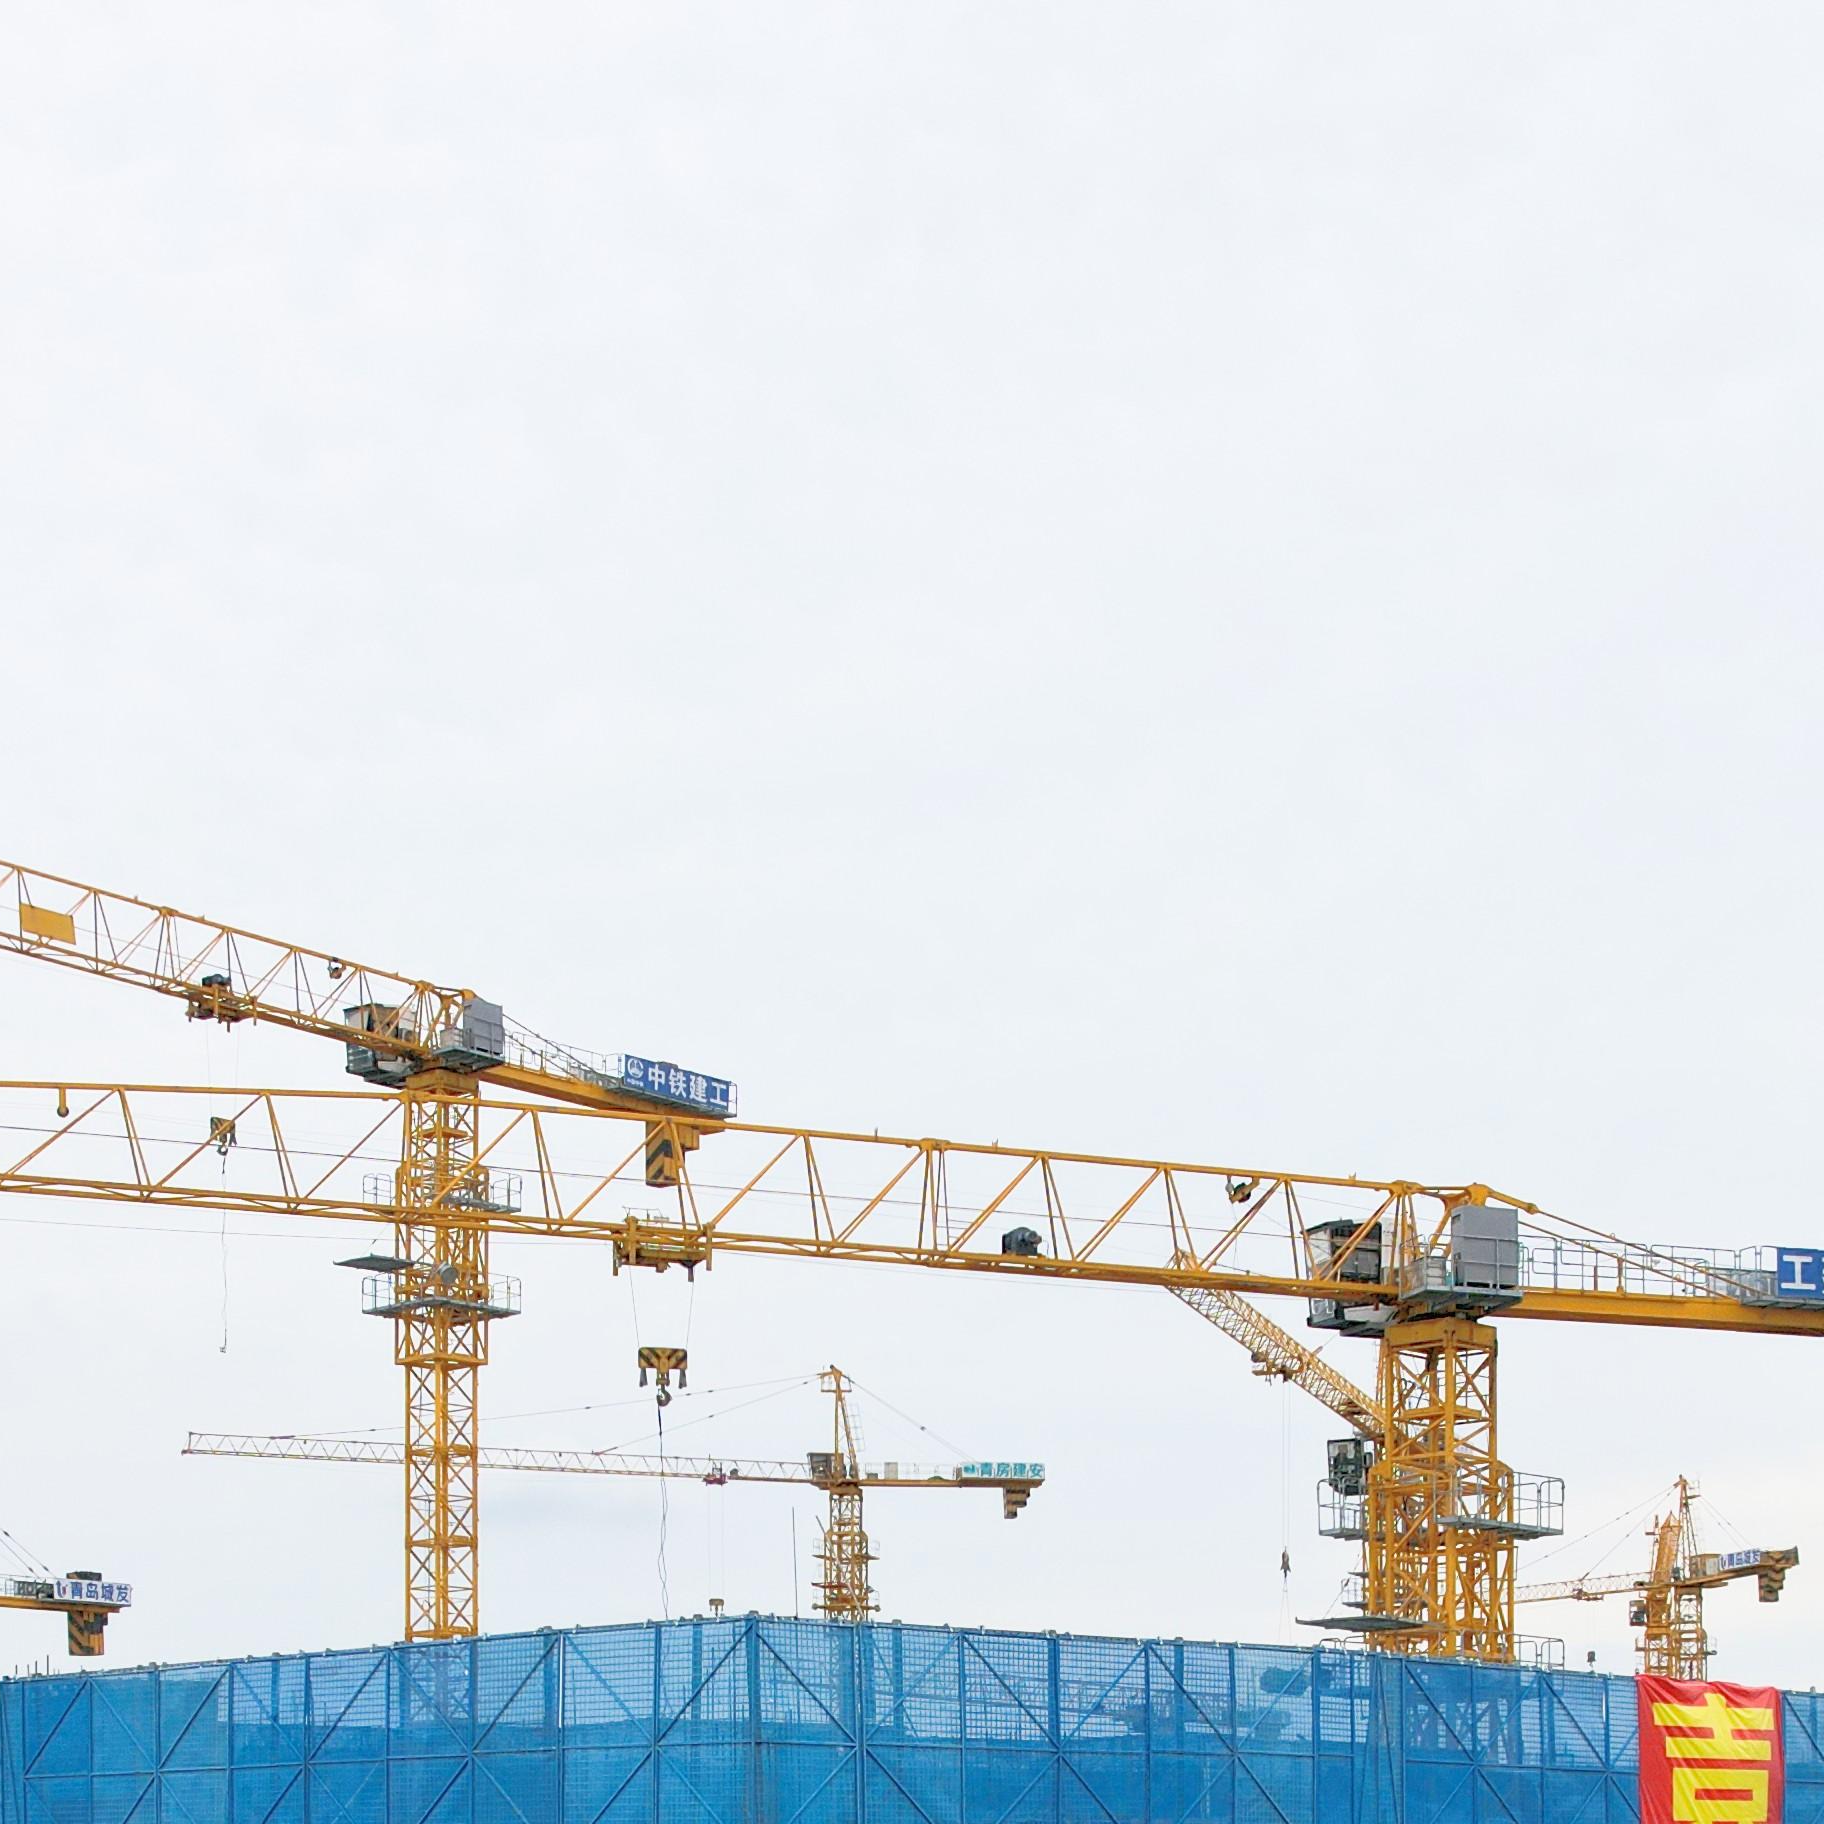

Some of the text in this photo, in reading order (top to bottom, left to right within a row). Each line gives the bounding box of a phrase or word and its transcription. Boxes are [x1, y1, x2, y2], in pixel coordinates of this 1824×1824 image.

[648, 1064, 728, 1106] 中铁建工
[71, 1581, 129, 1602] 青岛城发
